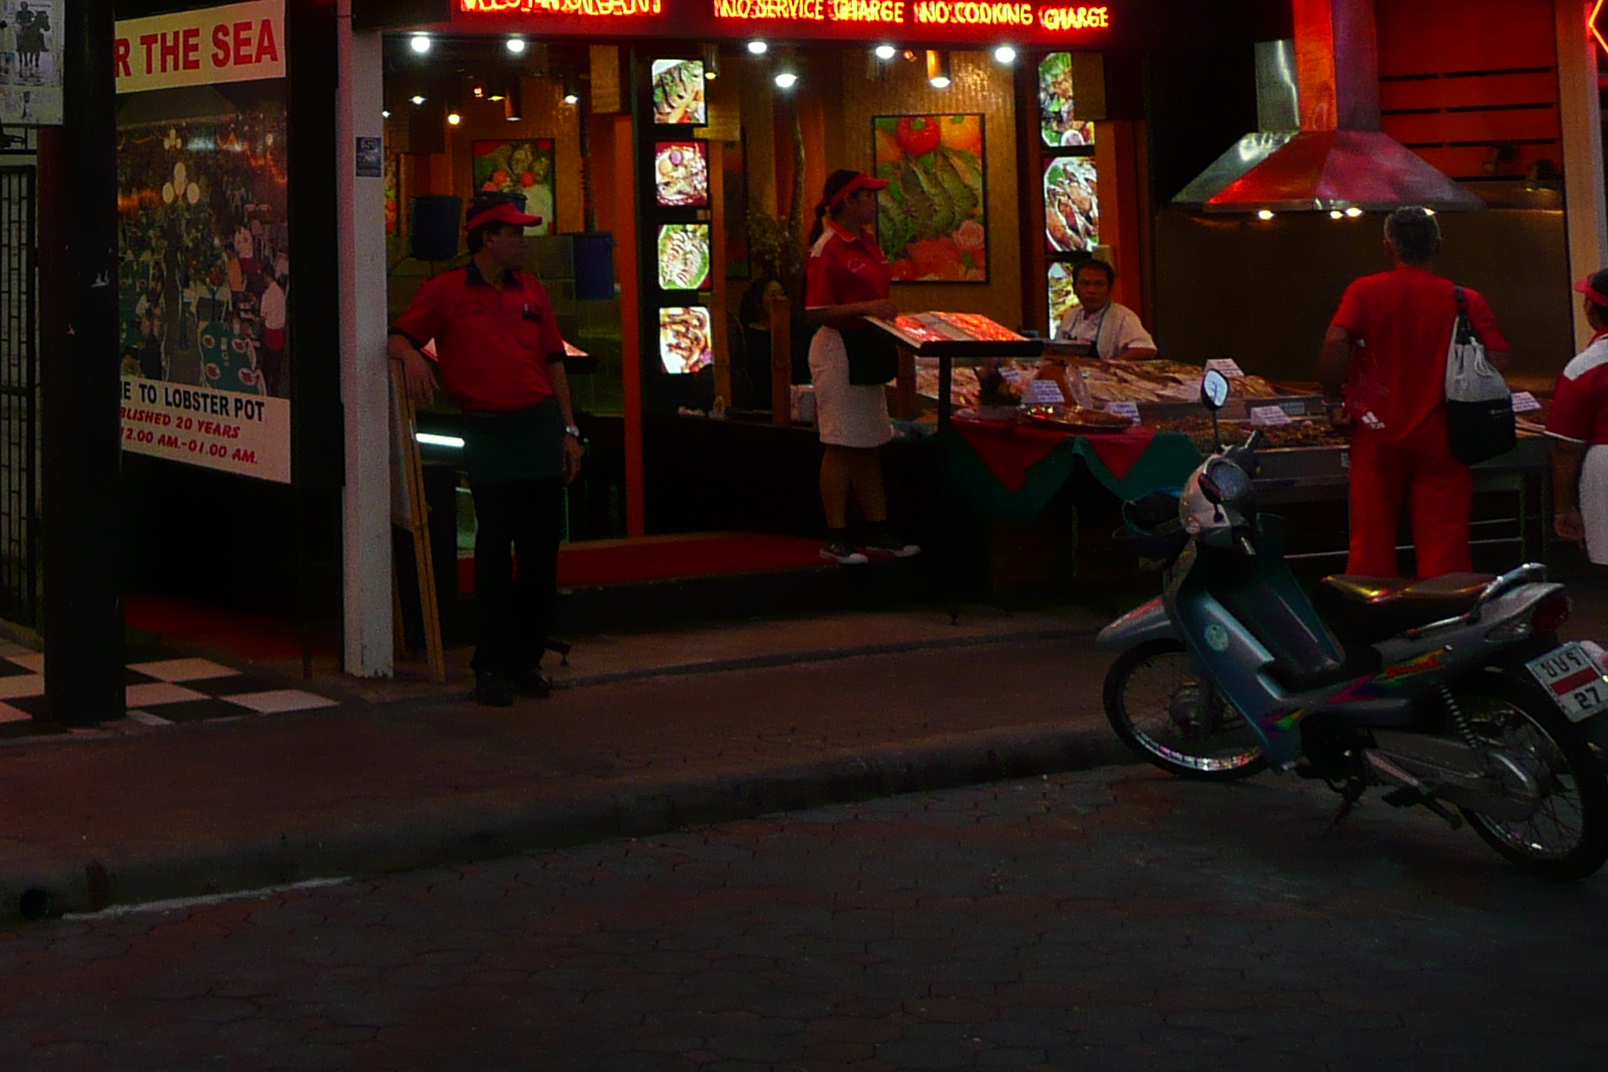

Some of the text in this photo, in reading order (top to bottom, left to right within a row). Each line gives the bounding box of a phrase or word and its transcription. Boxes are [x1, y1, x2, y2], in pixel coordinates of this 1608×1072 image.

[918, 0, 949, 25] NO
[952, 1, 1033, 26] COOKING
[1042, 6, 1109, 30] CHARGE
[139, 27, 201, 75] THE
[211, 18, 279, 68] SEA
[138, 382, 158, 404] TO
[164, 386, 230, 417] LOBSTER
[234, 397, 265, 422] POT
[176, 416, 193, 431] 20
[197, 419, 241, 440] YEARS
[1573, 686, 1603, 710] 27
